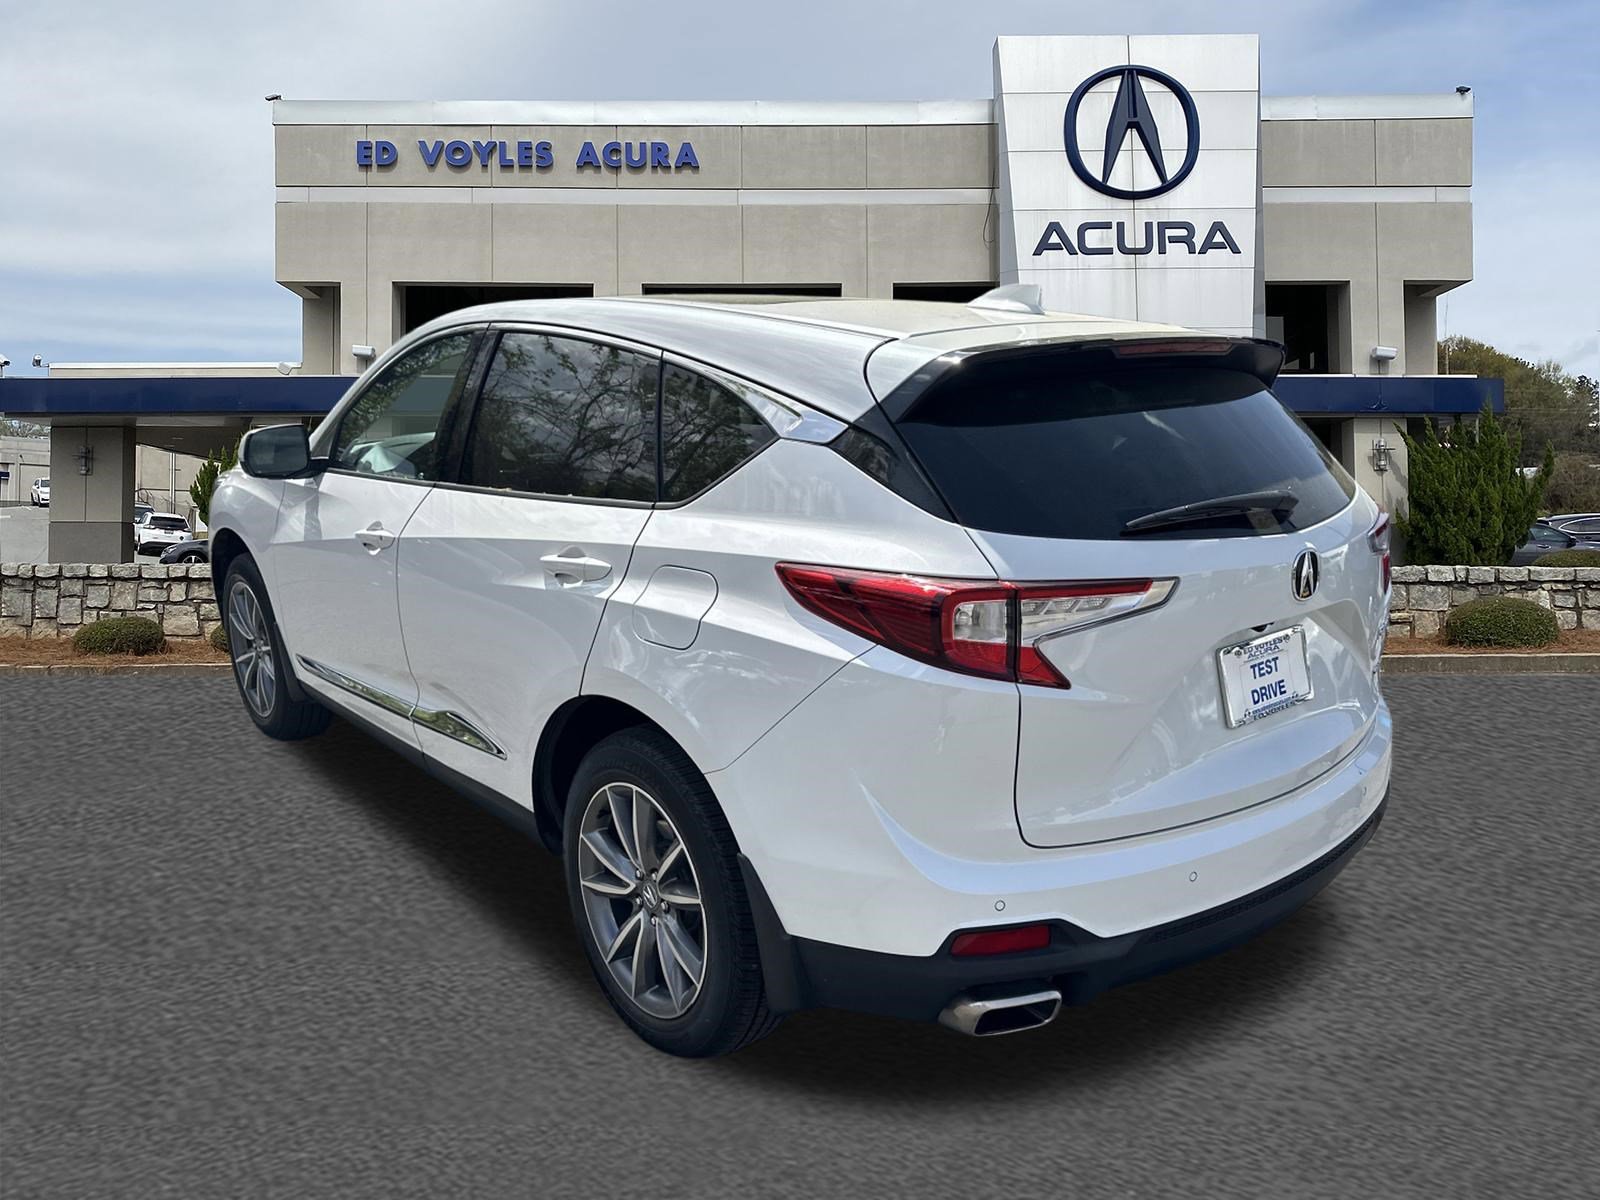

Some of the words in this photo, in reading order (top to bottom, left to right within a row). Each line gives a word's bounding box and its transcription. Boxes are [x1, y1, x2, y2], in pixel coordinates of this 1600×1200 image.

[356, 140, 398, 167] ED
[418, 140, 554, 168] VOYLES
[576, 141, 700, 168] ACURA
[1032, 221, 1242, 256] ACURA
[1247, 644, 1280, 659] ACURA
[1250, 656, 1279, 679] TEST
[1251, 679, 1287, 705] DRIVE
